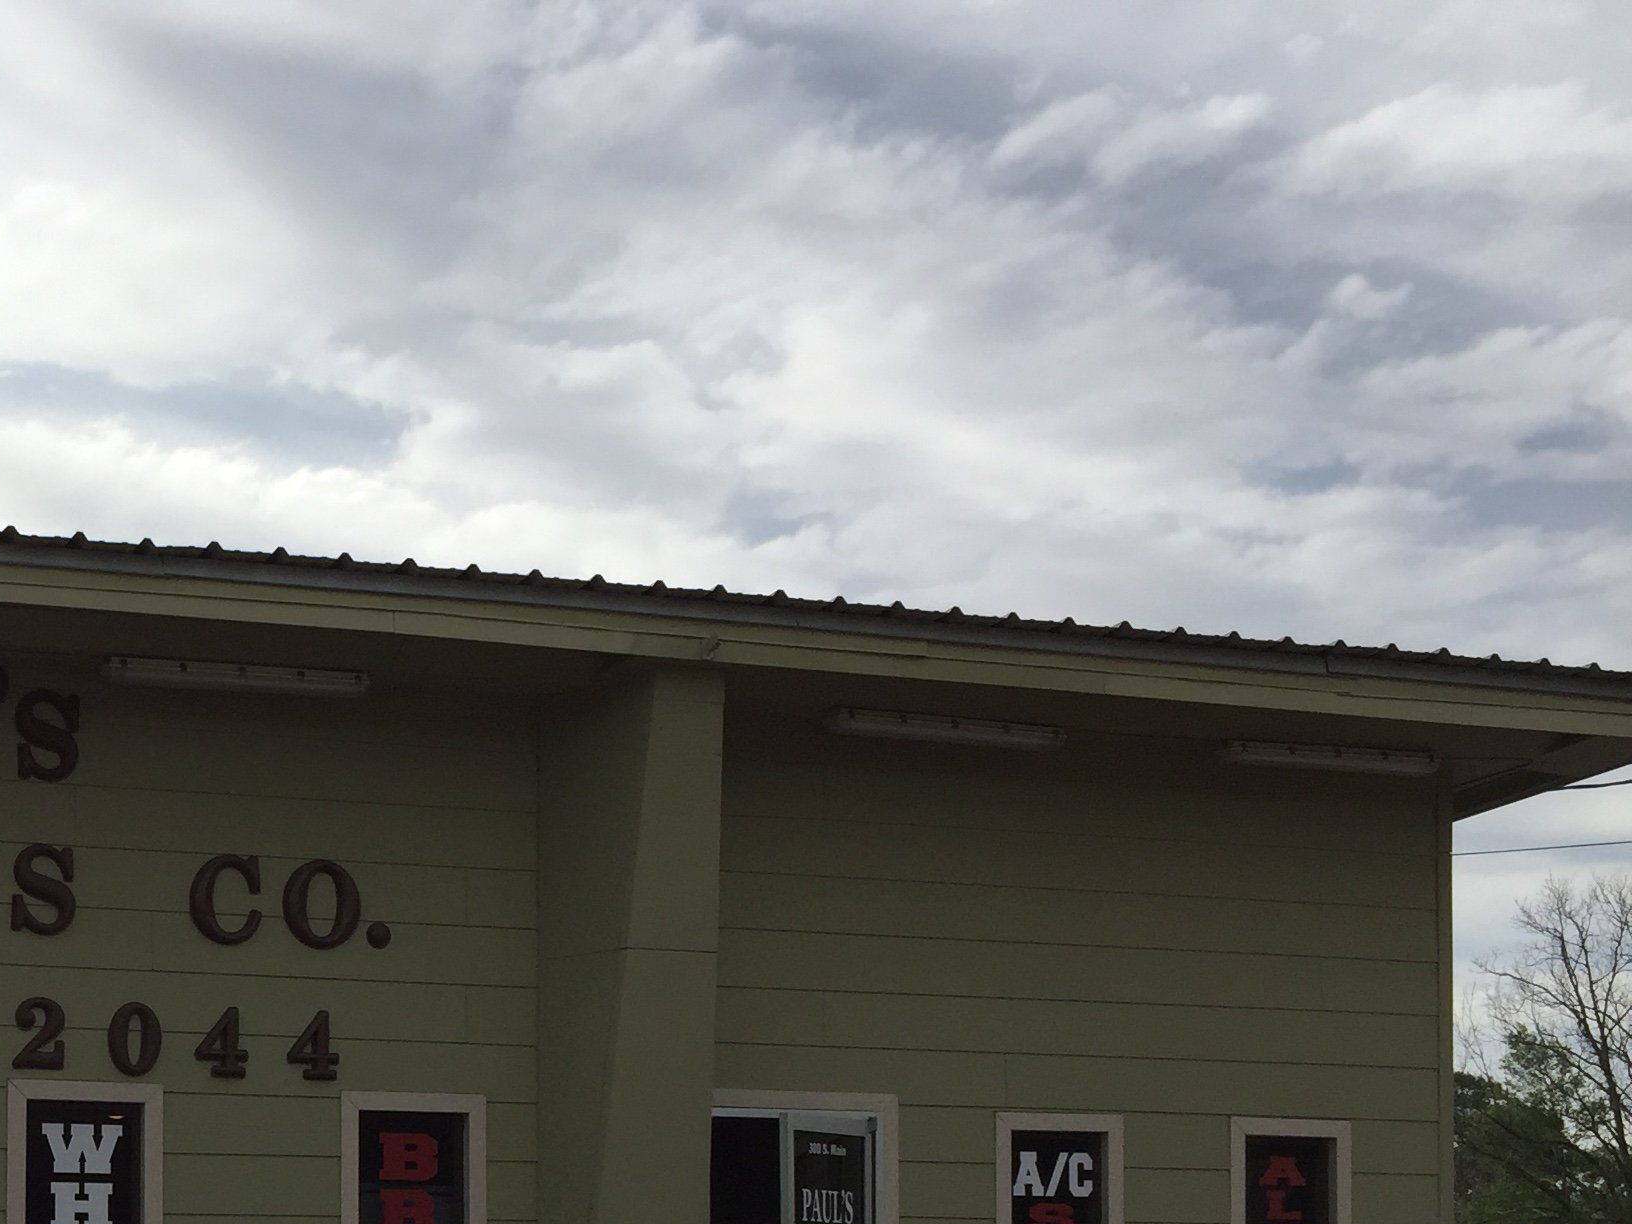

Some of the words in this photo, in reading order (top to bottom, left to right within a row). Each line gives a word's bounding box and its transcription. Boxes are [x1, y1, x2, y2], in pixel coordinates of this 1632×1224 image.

[190, 855, 393, 950] CO.
[1013, 1151, 1094, 1198] A/C
[801, 1187, 854, 1224] PAUL'S
